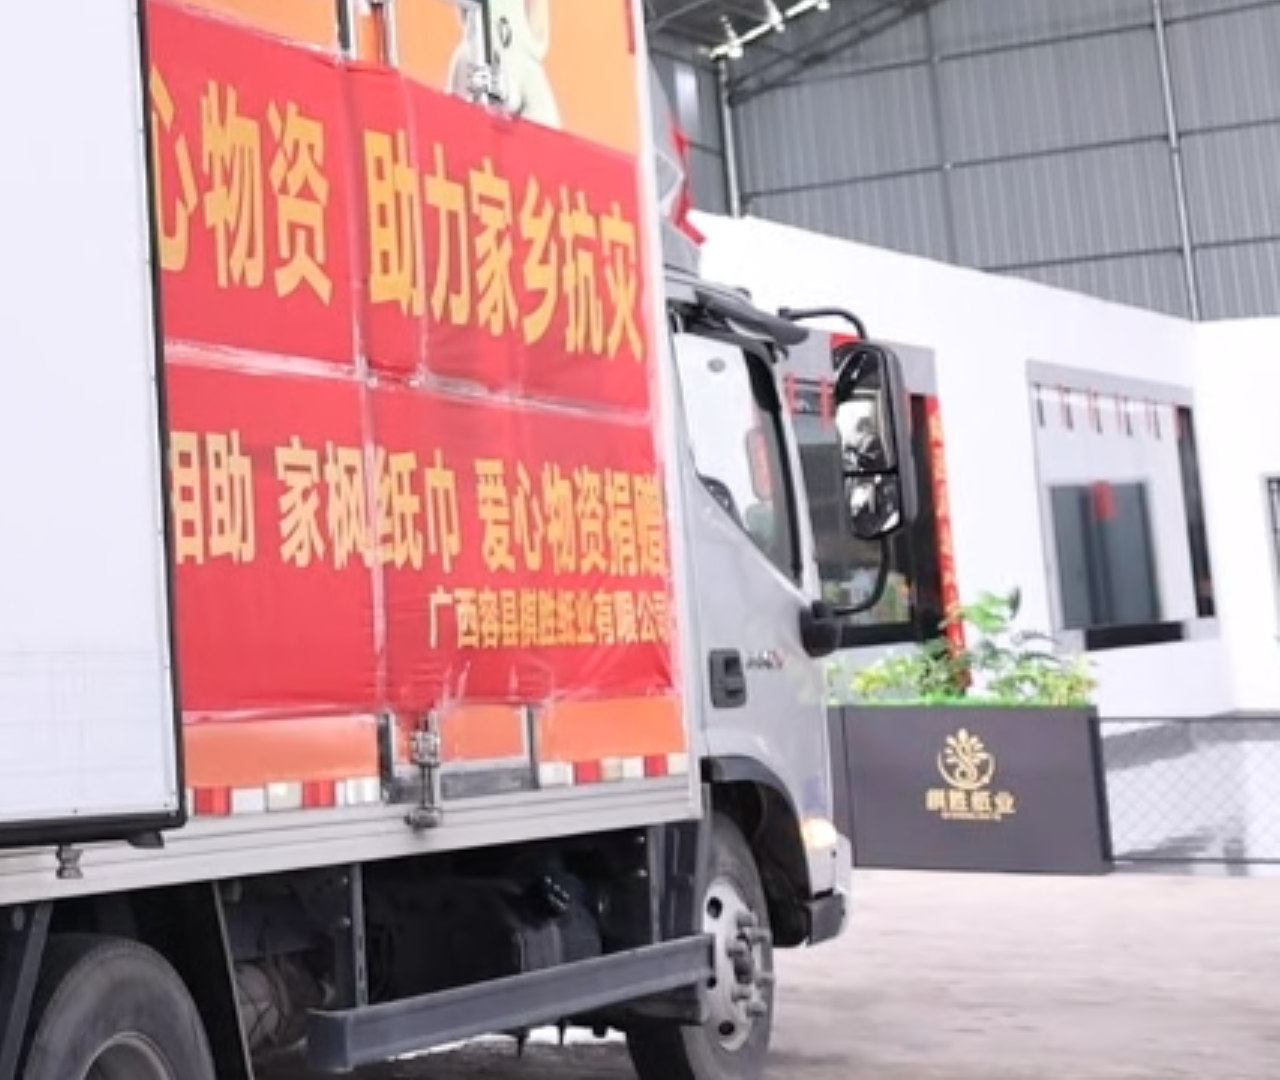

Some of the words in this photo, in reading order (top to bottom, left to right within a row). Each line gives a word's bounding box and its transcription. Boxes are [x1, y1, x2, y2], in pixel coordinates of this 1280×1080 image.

[362, 128, 643, 359] 助力家乡抗灾
[274, 434, 462, 575] 家枫纸巾
[474, 457, 669, 578] 爱心物资捐赠
